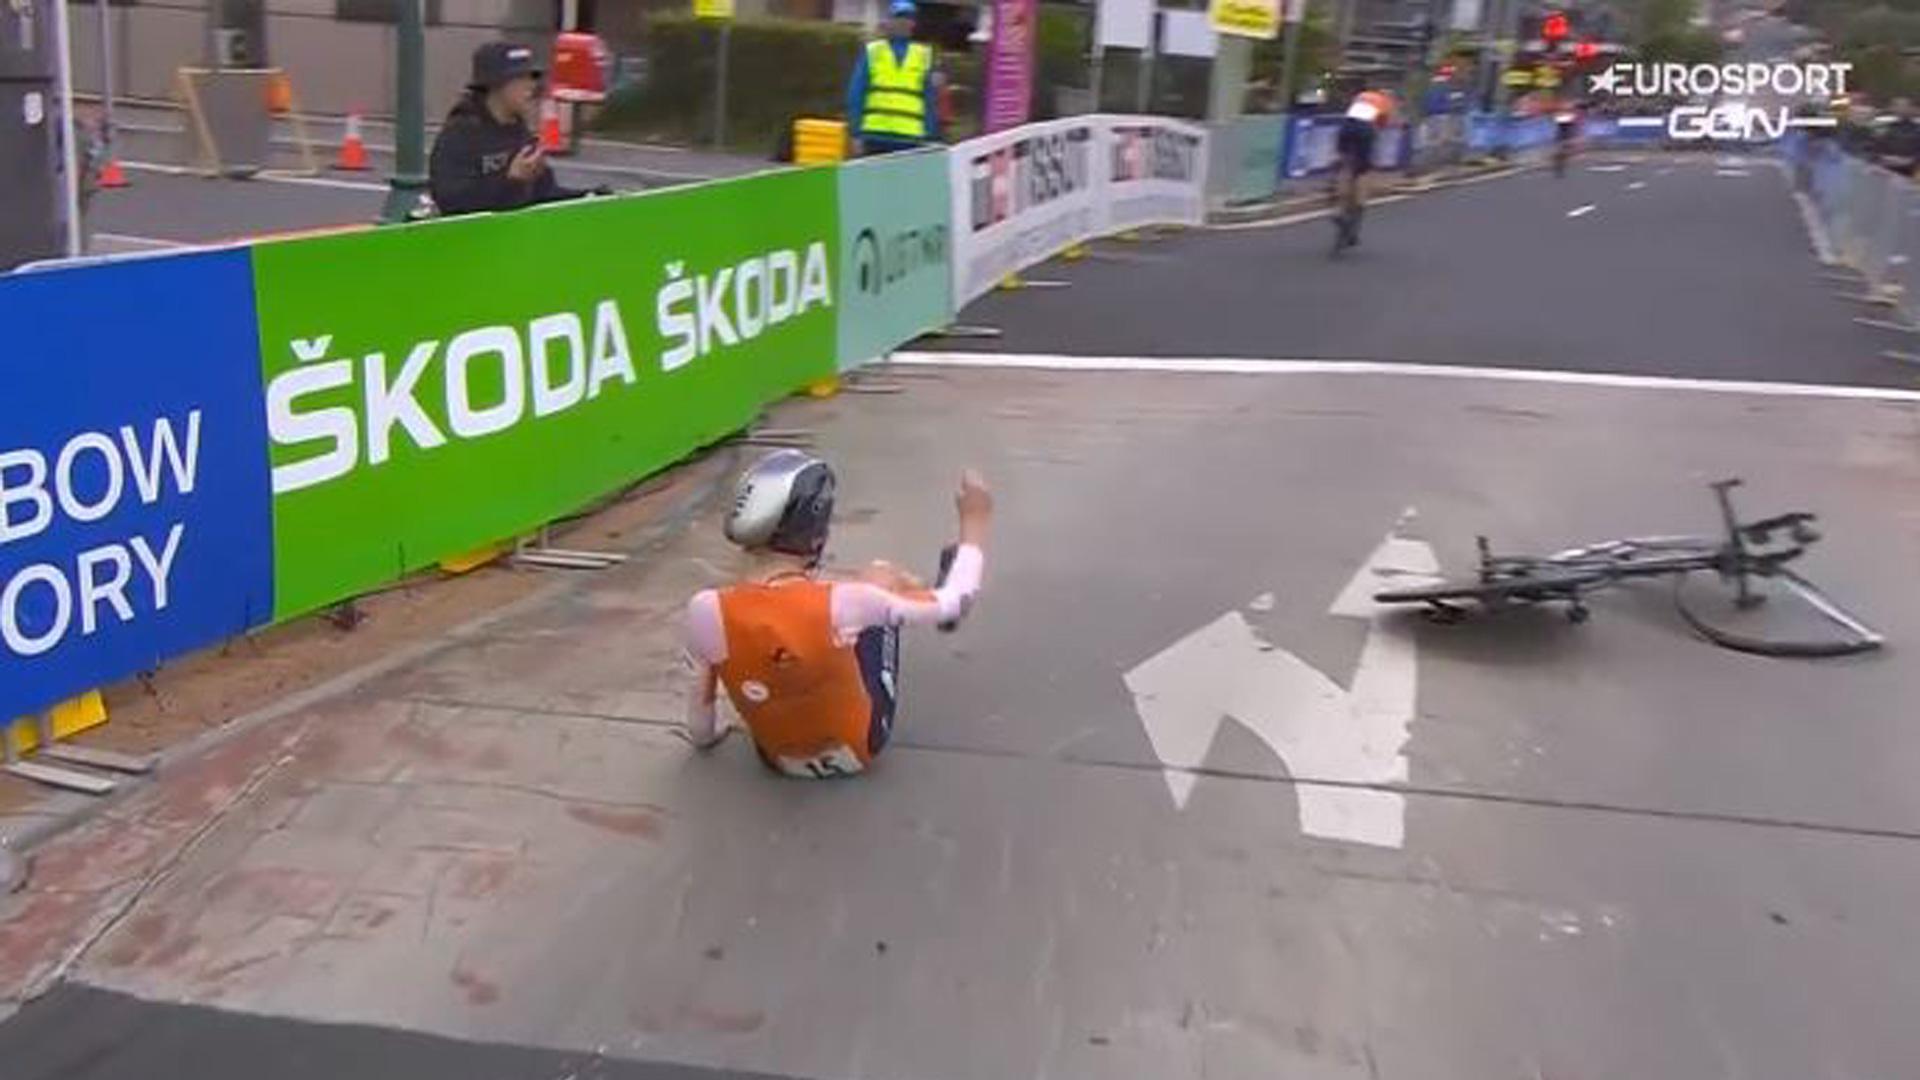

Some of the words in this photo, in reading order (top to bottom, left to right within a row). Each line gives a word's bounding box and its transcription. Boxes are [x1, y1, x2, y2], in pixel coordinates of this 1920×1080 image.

[266, 300, 637, 494] ŠKODA
[656, 242, 833, 372] ŠKODA
[0, 410, 201, 543] BOW
[0, 523, 184, 656] ORY
